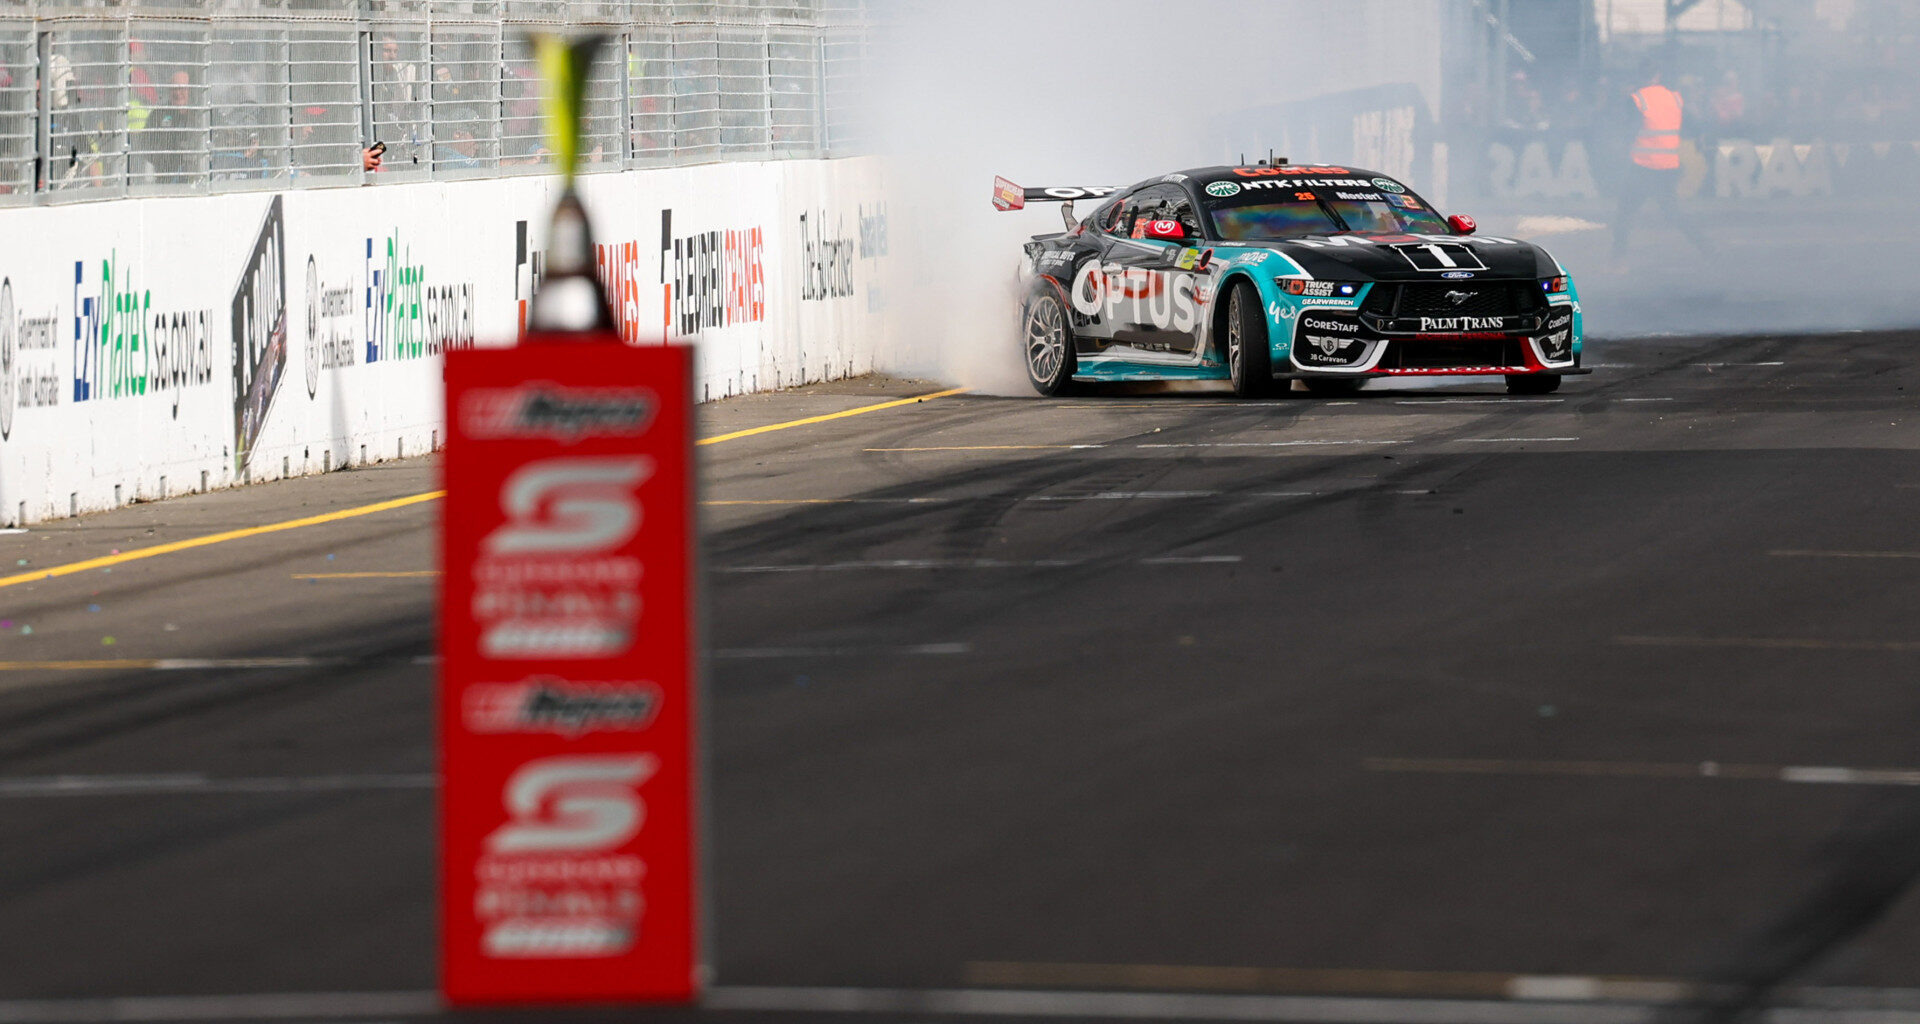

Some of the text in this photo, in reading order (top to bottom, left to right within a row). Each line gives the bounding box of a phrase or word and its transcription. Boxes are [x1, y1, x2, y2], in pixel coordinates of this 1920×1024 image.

[1240, 179, 1371, 191] NTK FILTERS
[1294, 192, 1316, 201] 25
[1335, 191, 1383, 200] Mostert
[674, 231, 723, 337] FLEURIEU
[725, 225, 765, 327] CRANES
[1305, 280, 1335, 289] TRUCK
[1072, 259, 1195, 333] OPTUS
[1302, 288, 1333, 297] ASSIST
[1301, 298, 1354, 306] GEARWRENCH
[1269, 301, 1296, 324] yes
[1318, 354, 1347, 364] Caravans
